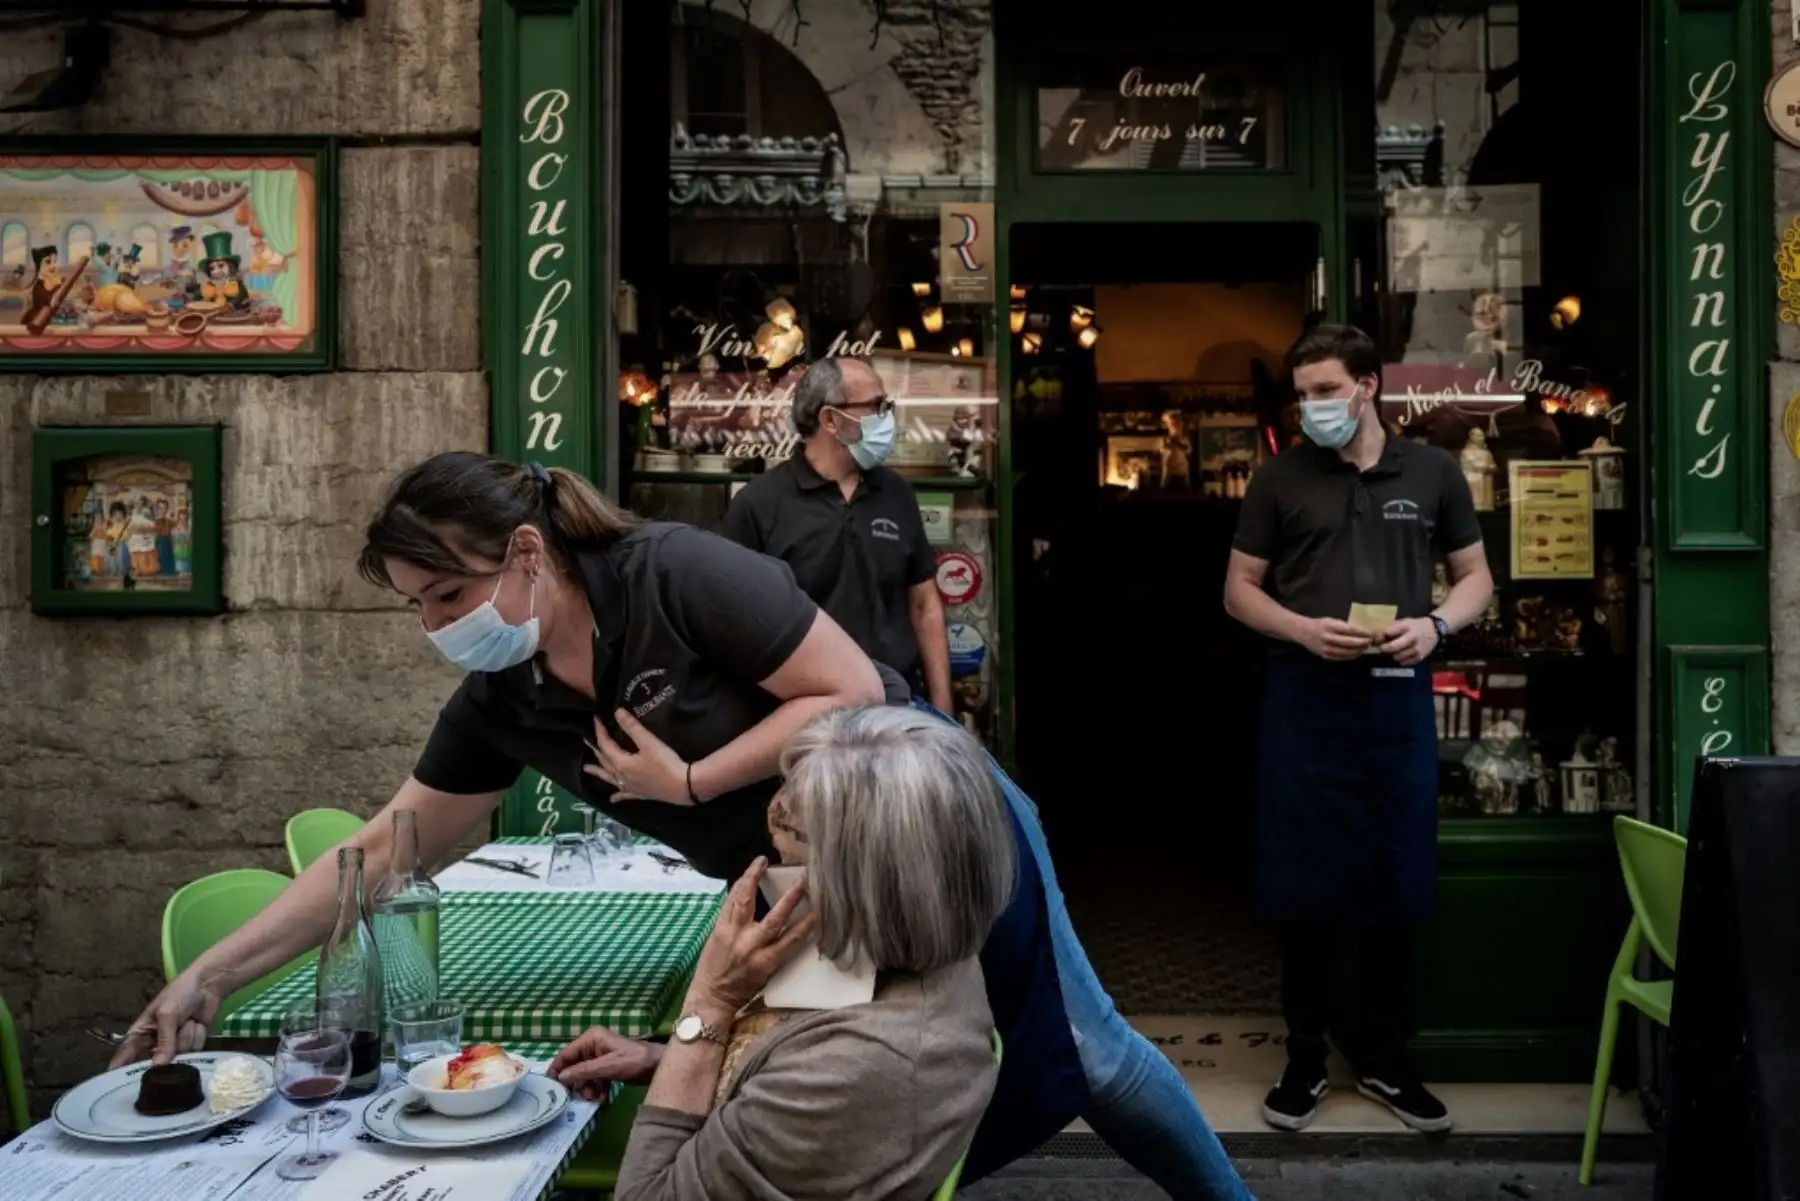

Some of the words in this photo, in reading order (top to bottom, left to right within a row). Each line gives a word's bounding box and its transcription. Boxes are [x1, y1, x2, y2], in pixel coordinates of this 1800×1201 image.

[1119, 66, 1206, 97] Ouvert
[1067, 118, 1087, 146] 7
[1099, 118, 1172, 150] jours
[1185, 122, 1226, 140] sur
[1238, 117, 1257, 144] 7
[519, 88, 571, 452] Bouchon
[1679, 60, 1736, 480] Lyonnais
[692, 323, 753, 357] Vin
[826, 330, 882, 358] pot
